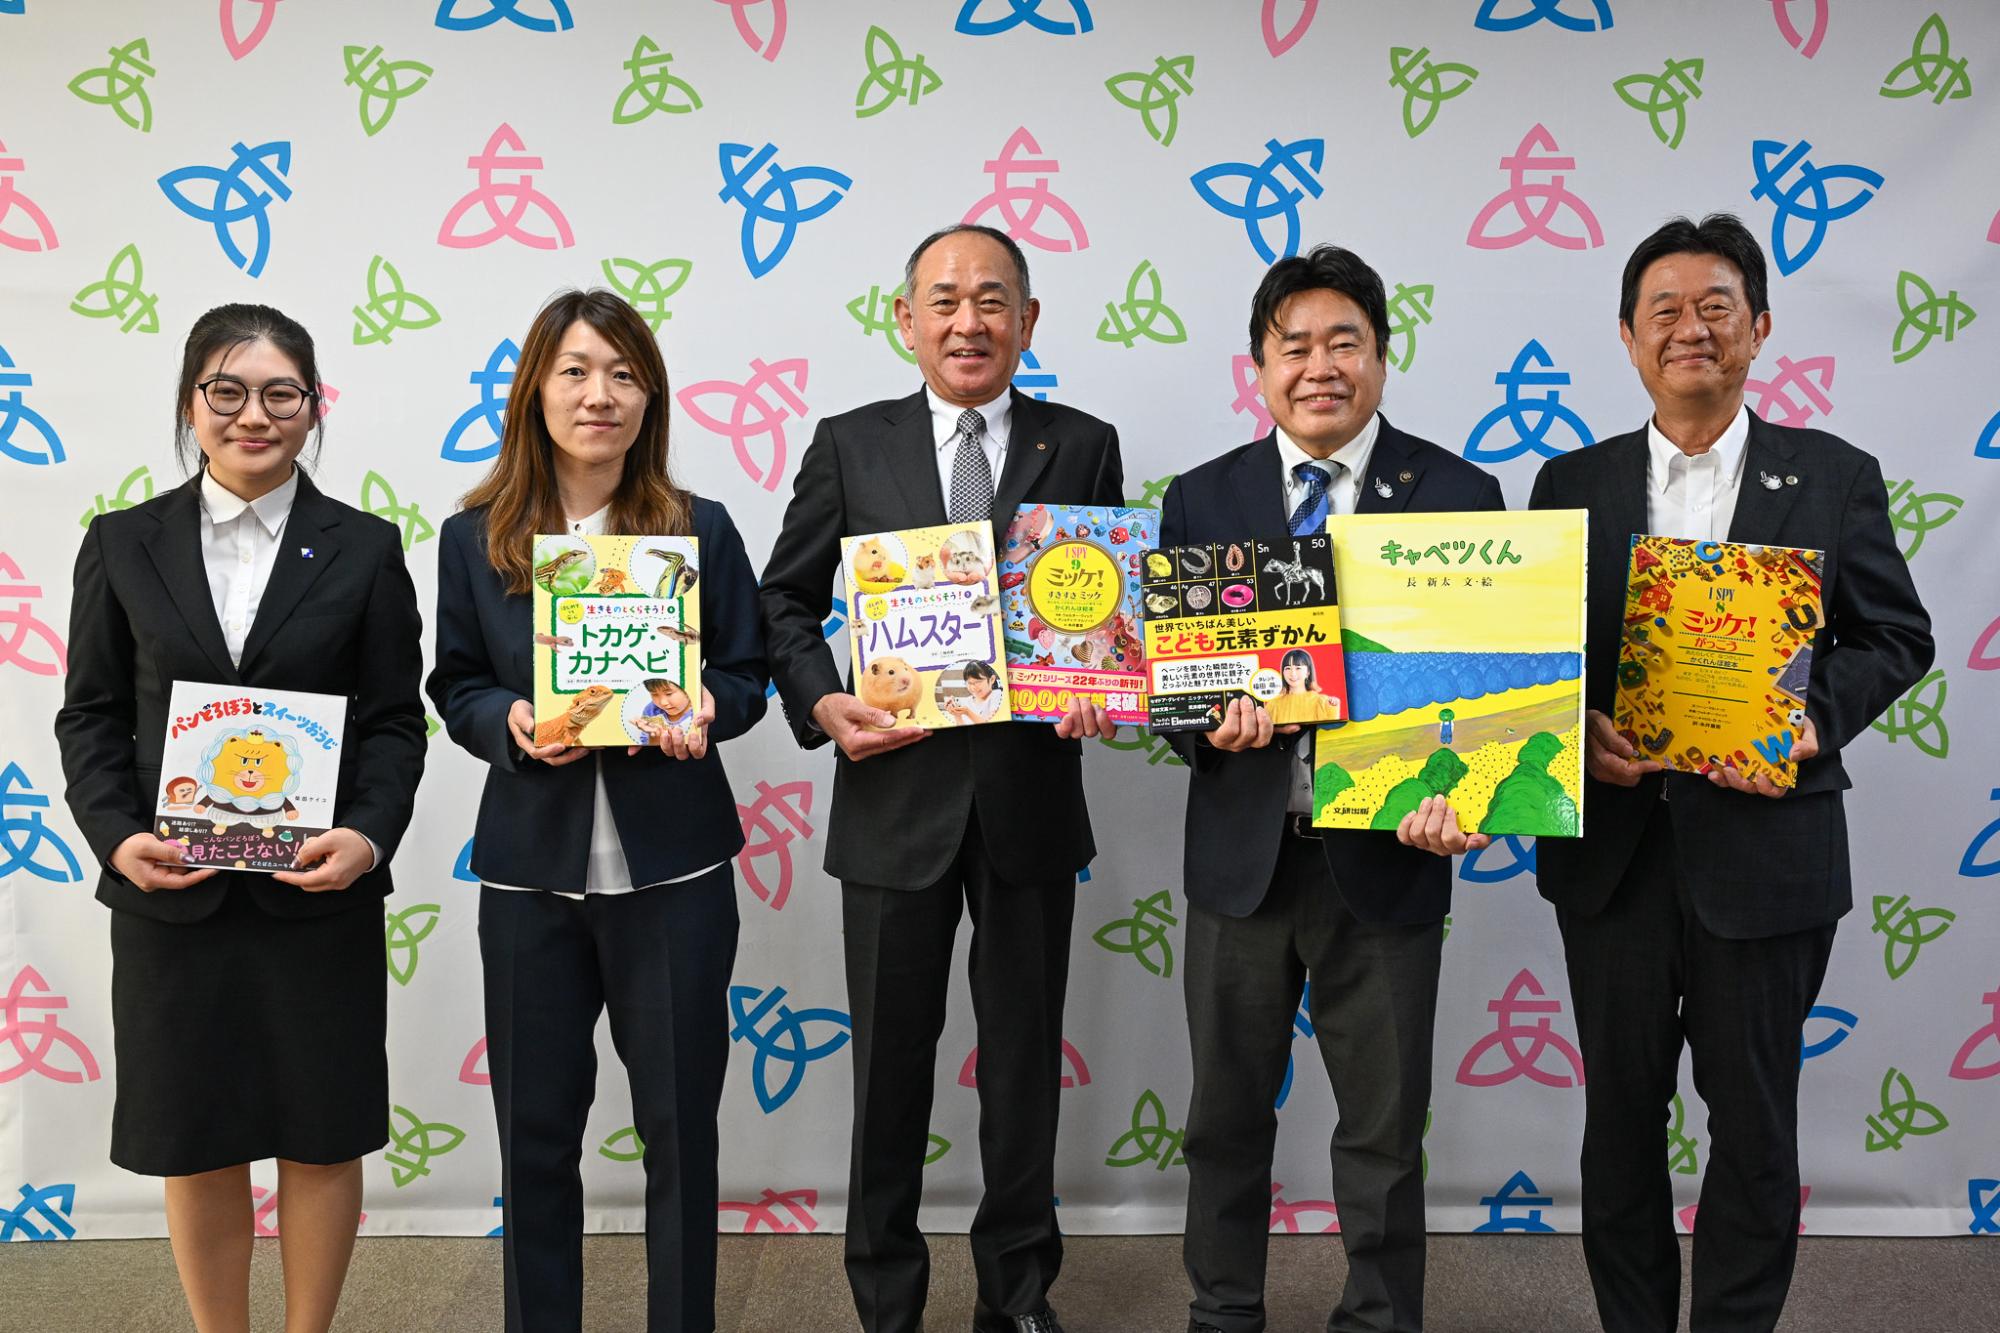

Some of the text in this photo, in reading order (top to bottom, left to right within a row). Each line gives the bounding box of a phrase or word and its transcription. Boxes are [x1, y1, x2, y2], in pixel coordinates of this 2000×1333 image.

[1257, 543, 1270, 554] Sn
[1311, 538, 1325, 549] 50
[1065, 547, 1087, 559] I SPY
[1380, 539, 1522, 566] キャベツくん
[1071, 559, 1081, 570] 9
[1046, 567, 1104, 588] ミッケ!
[1406, 577, 1417, 588] 長
[1427, 577, 1451, 587] 新太
[1048, 591, 1102, 600] すきすき ミッケ
[1709, 587, 1735, 601] I SPY
[587, 605, 665, 615] 生きものとくらそう!
[1155, 616, 1256, 633] 世界でいちばん美しい
[1680, 609, 1757, 638] ミッケ!
[582, 622, 656, 648] トカゲ・
[869, 611, 981, 652] ハムスター
[1155, 623, 1327, 654] こども元素ずかん
[1695, 637, 1738, 651] がっこう
[568, 648, 670, 675] カナヘビ
[1690, 657, 1738, 668] かくれんぼ絵本
[1162, 665, 1251, 680] 美しい元素の世界に親子で
[171, 697, 339, 751] パンどろぼうとスイーツおうじ
[1171, 716, 1210, 726] Elements
[203, 835, 261, 843] こんなパンどろぼう
[191, 841, 300, 861] 見たことない!
